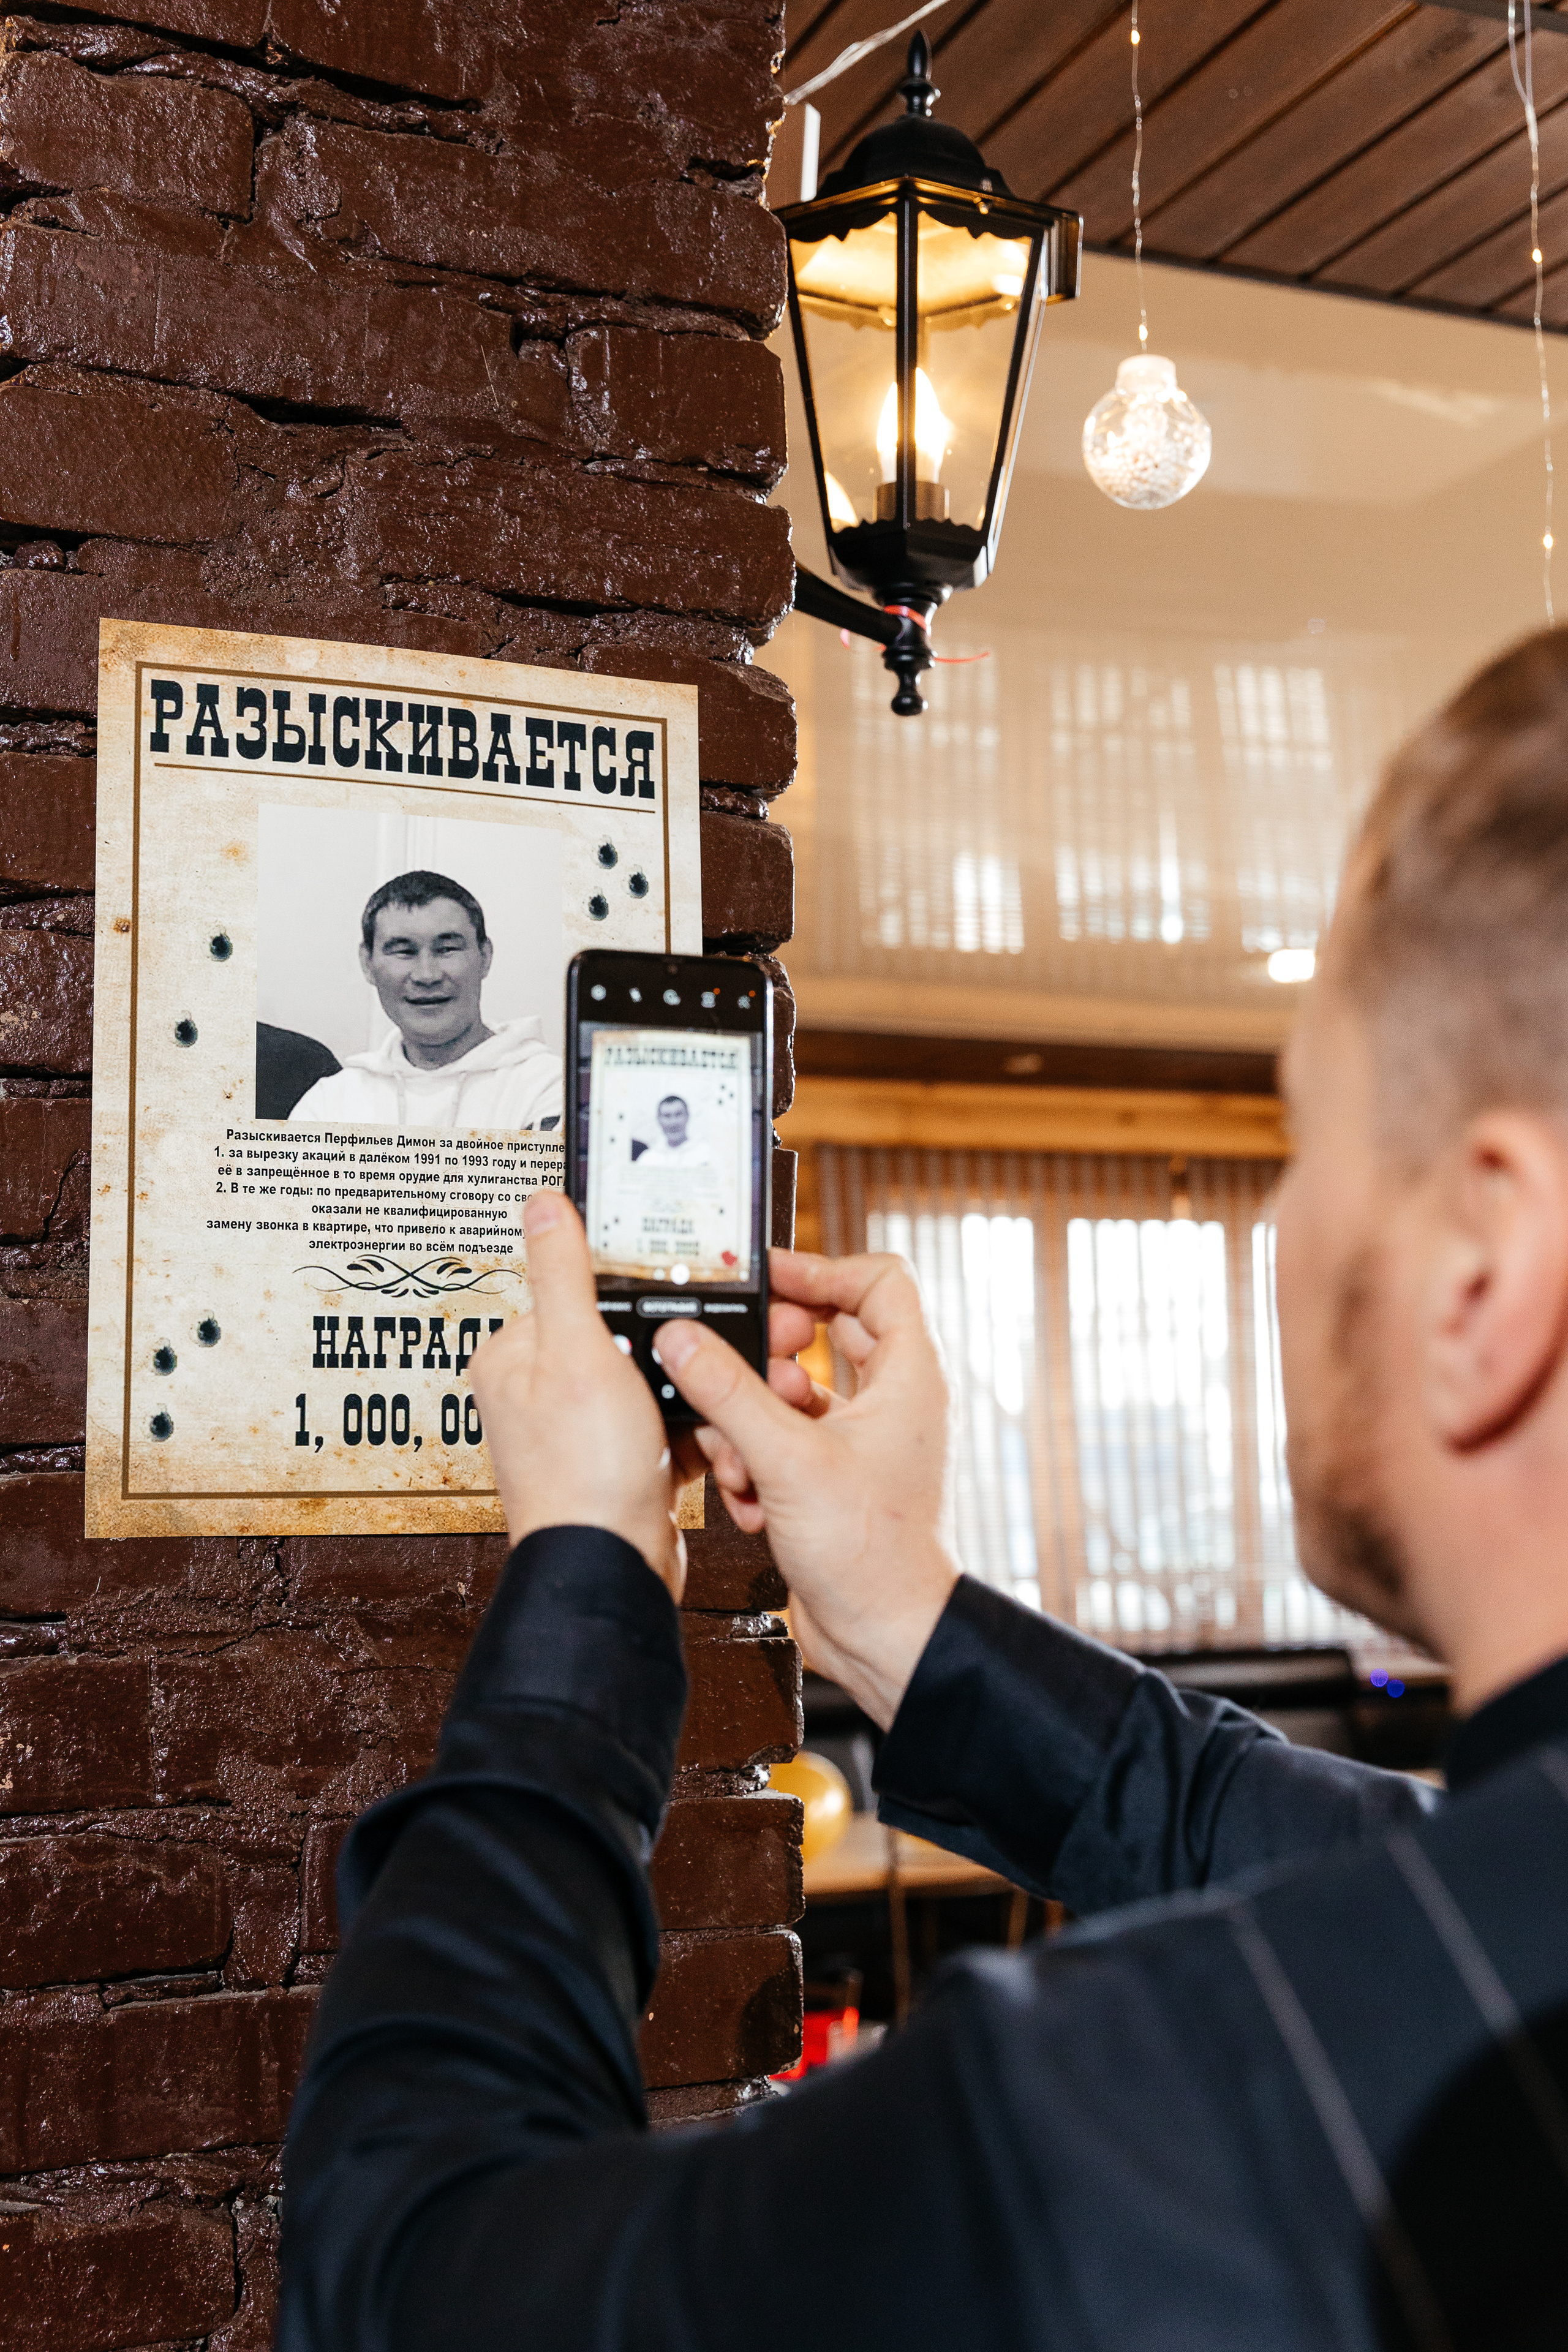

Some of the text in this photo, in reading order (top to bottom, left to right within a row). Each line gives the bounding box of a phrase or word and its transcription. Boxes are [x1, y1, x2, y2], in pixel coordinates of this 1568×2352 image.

[150, 678, 655, 799] РАЗЫСКИВАЕТСЯ
[226, 1128, 321, 1143] Разыскивается
[325, 1133, 393, 1147] Перфильев
[396, 1135, 435, 1148] Димон
[439, 1139, 453, 1148] за
[456, 1138, 503, 1150] двойное
[214, 1145, 224, 1157] 1.
[228, 1149, 243, 1158] за
[247, 1150, 298, 1163] вырезку
[302, 1150, 345, 1163] акаций
[349, 1153, 356, 1162] в
[359, 1152, 410, 1164] далёком
[414, 1153, 440, 1164] 1991
[445, 1156, 458, 1165] по
[462, 1155, 489, 1166] 1993
[492, 1159, 516, 1170] году
[217, 1164, 232, 1175] её
[246, 1166, 330, 1180] запрещённое
[343, 1170, 355, 1179] то
[360, 1171, 395, 1183] время
[399, 1172, 440, 1184] орудие
[443, 1174, 464, 1185] для
[467, 1174, 538, 1186] хулиганства
[541, 1175, 566, 1186] РОГ
[216, 1182, 227, 1193] 2.
[231, 1182, 239, 1193] В
[243, 1185, 255, 1194] те
[259, 1186, 276, 1194] же
[280, 1186, 313, 1197] годы:
[317, 1187, 331, 1196] по
[334, 1188, 446, 1202] предварительному
[450, 1191, 494, 1204] сговору
[498, 1193, 511, 1202] со
[311, 1205, 361, 1215] оказали
[383, 1205, 507, 1221] квалифицированную
[206, 1219, 252, 1232] замену
[255, 1221, 299, 1231] звонка
[313, 1223, 371, 1235] квартире,
[374, 1224, 393, 1233] что
[398, 1225, 446, 1236] привело
[309, 1240, 513, 1255] электроэнергии во всём подъезде
[295, 1393, 324, 1453] 1,
[343, 1393, 423, 1453] 000,
